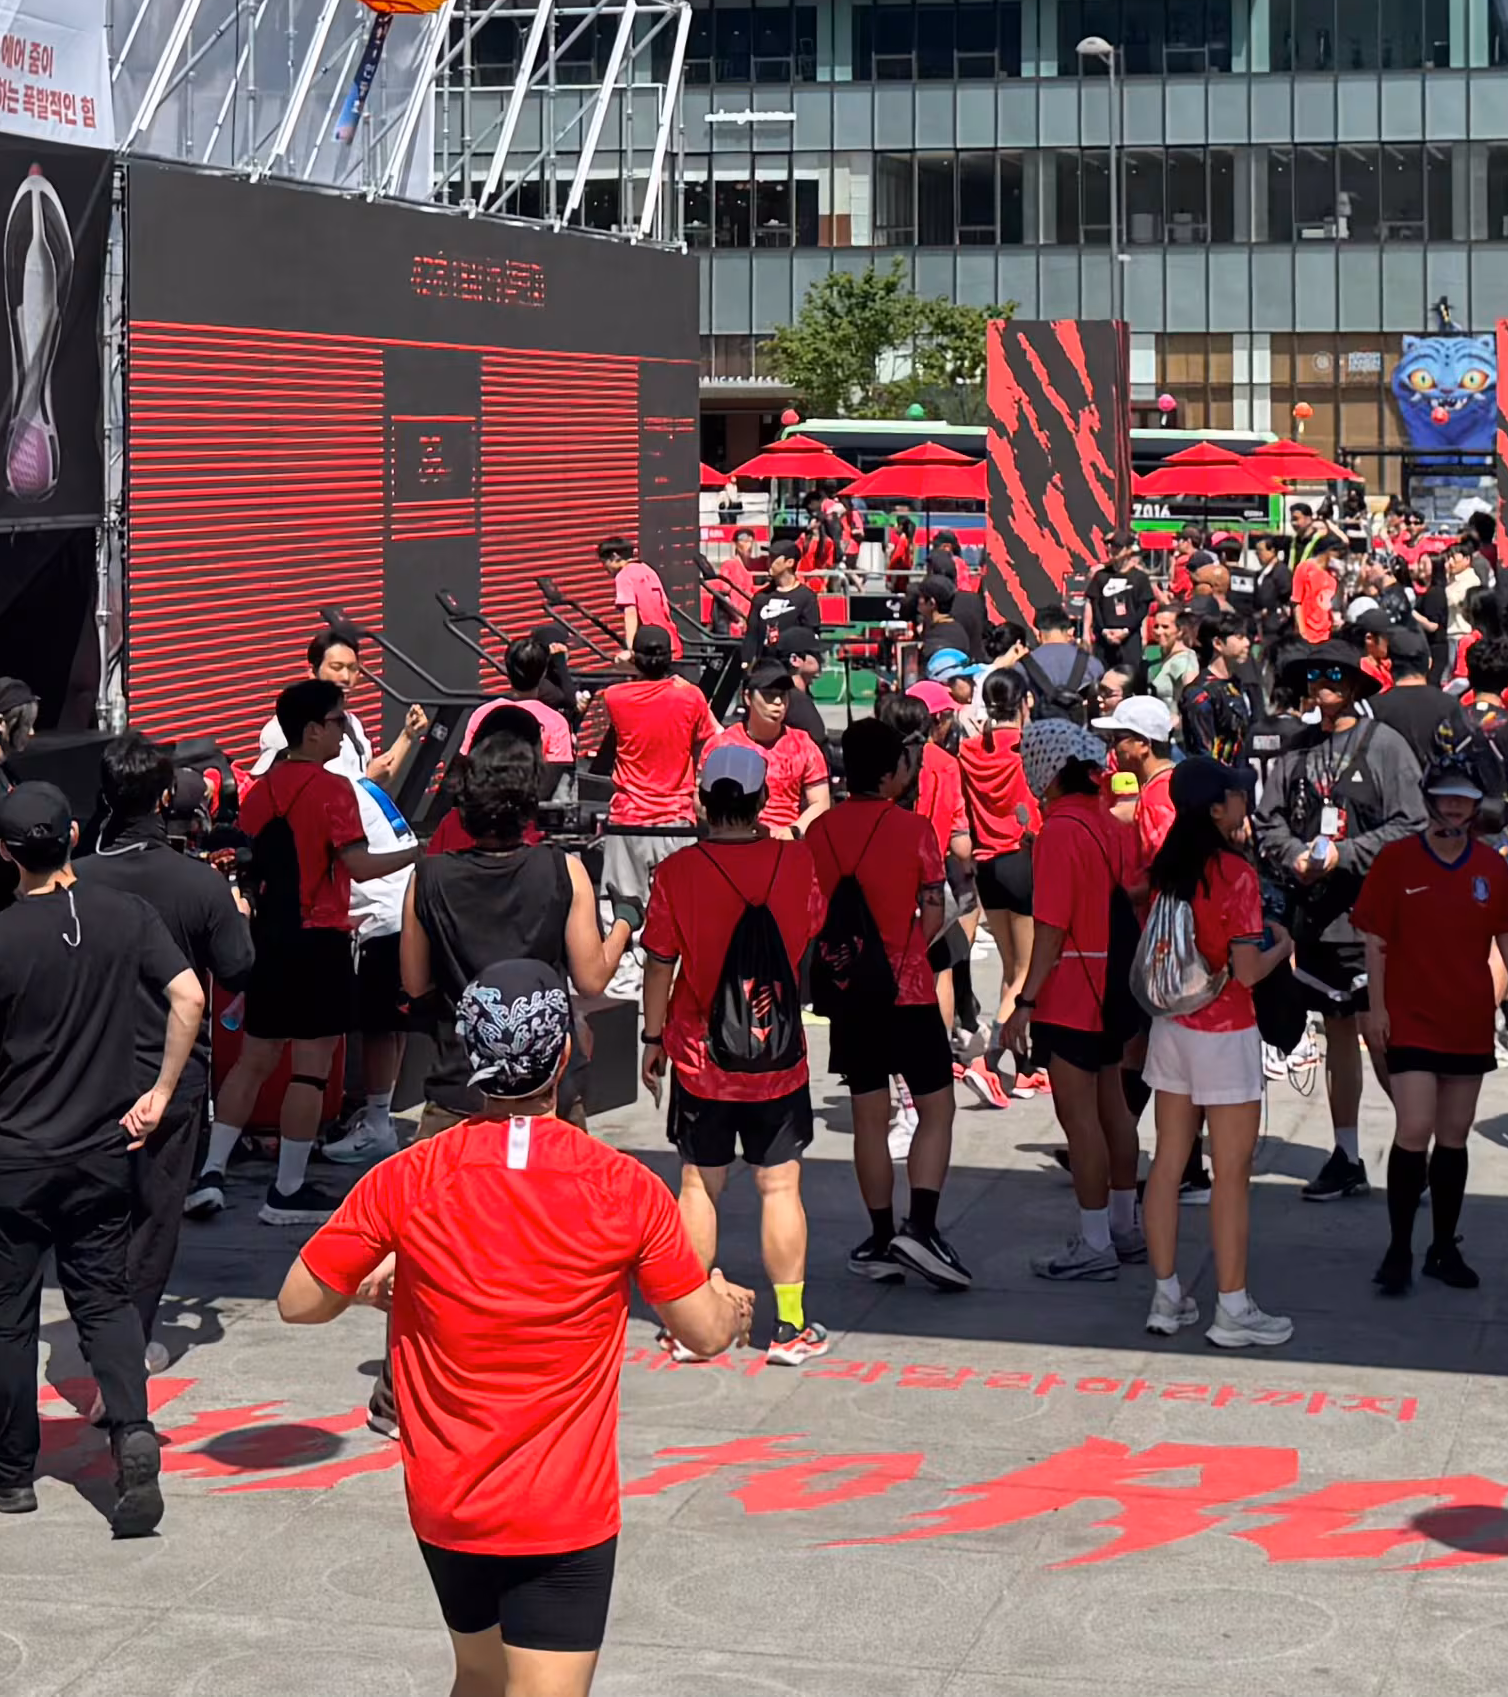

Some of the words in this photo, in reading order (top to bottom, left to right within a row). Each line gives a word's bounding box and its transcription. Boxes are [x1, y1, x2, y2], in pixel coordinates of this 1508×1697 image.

[1, 34, 26, 71] 에어
[28, 41, 54, 79] 줌이
[23, 84, 78, 126] 폭발적인
[80, 95, 97, 129] 힘
